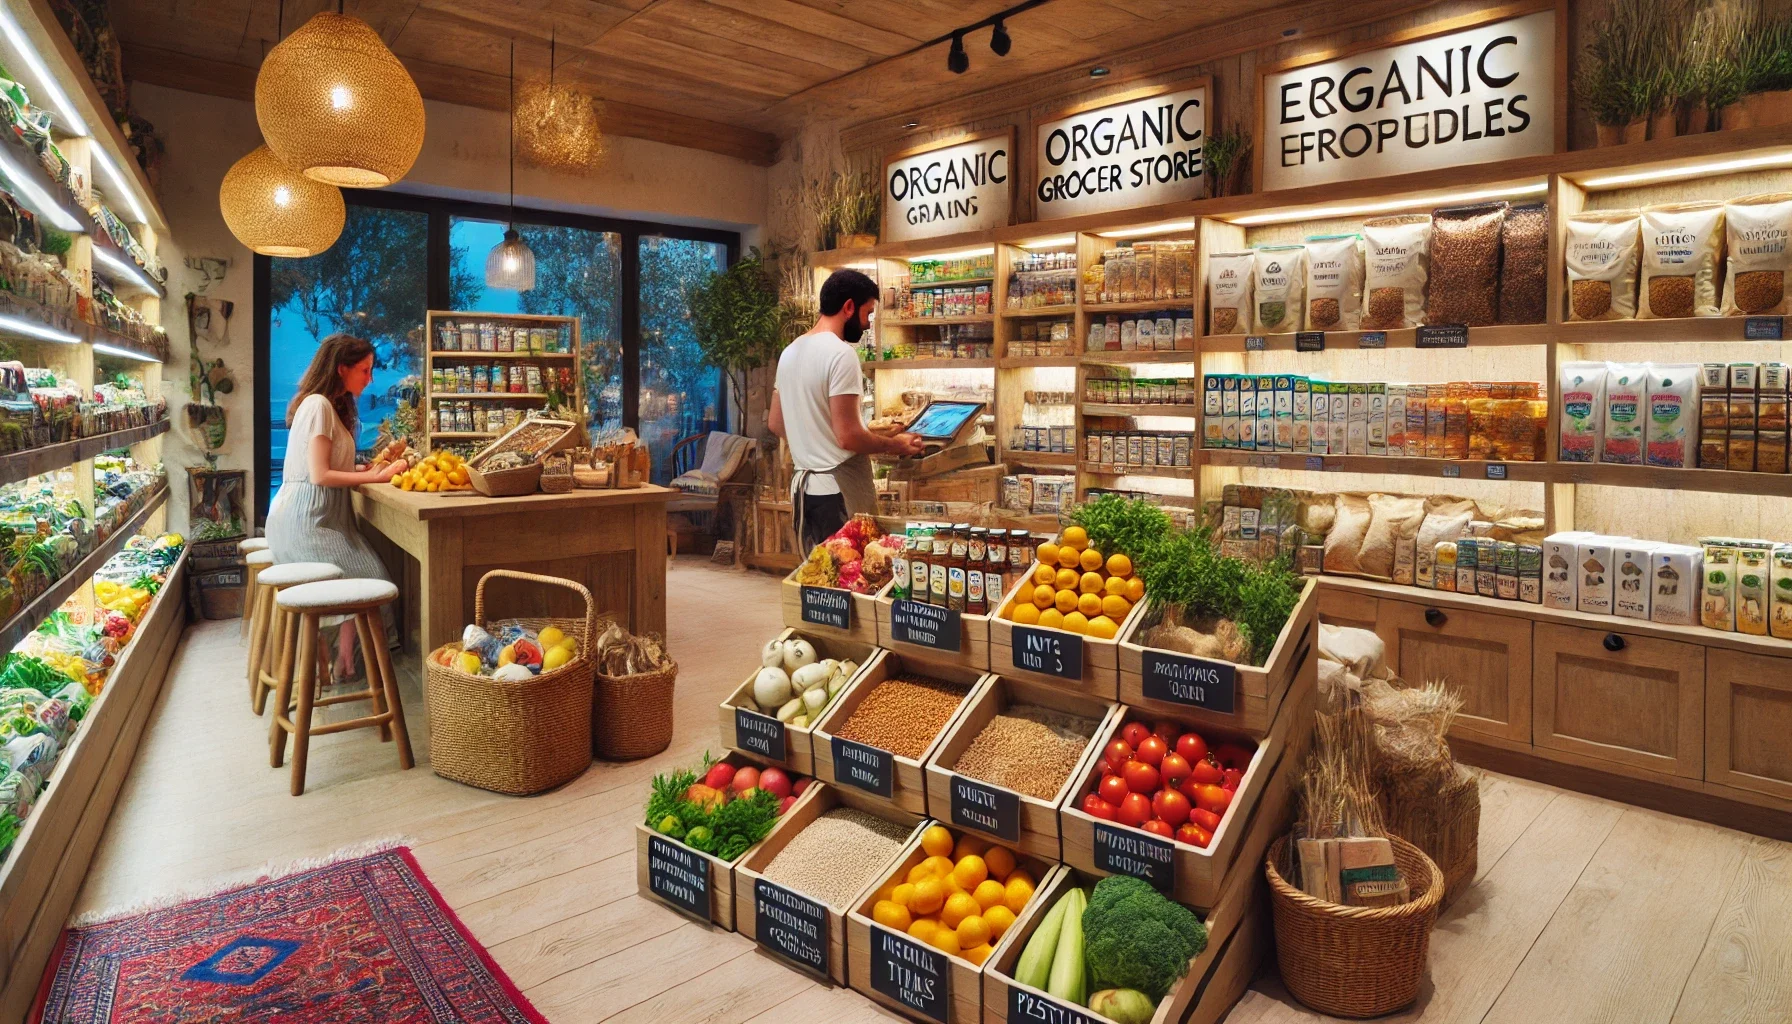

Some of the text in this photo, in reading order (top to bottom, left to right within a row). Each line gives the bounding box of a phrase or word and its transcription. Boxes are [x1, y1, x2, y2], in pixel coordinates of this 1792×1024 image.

[1045, 99, 1202, 166] ORGANIC
[889, 149, 1007, 202] ORGANIC
[1037, 147, 1203, 203] GROCER STORE
[906, 196, 979, 226] GRAINS
